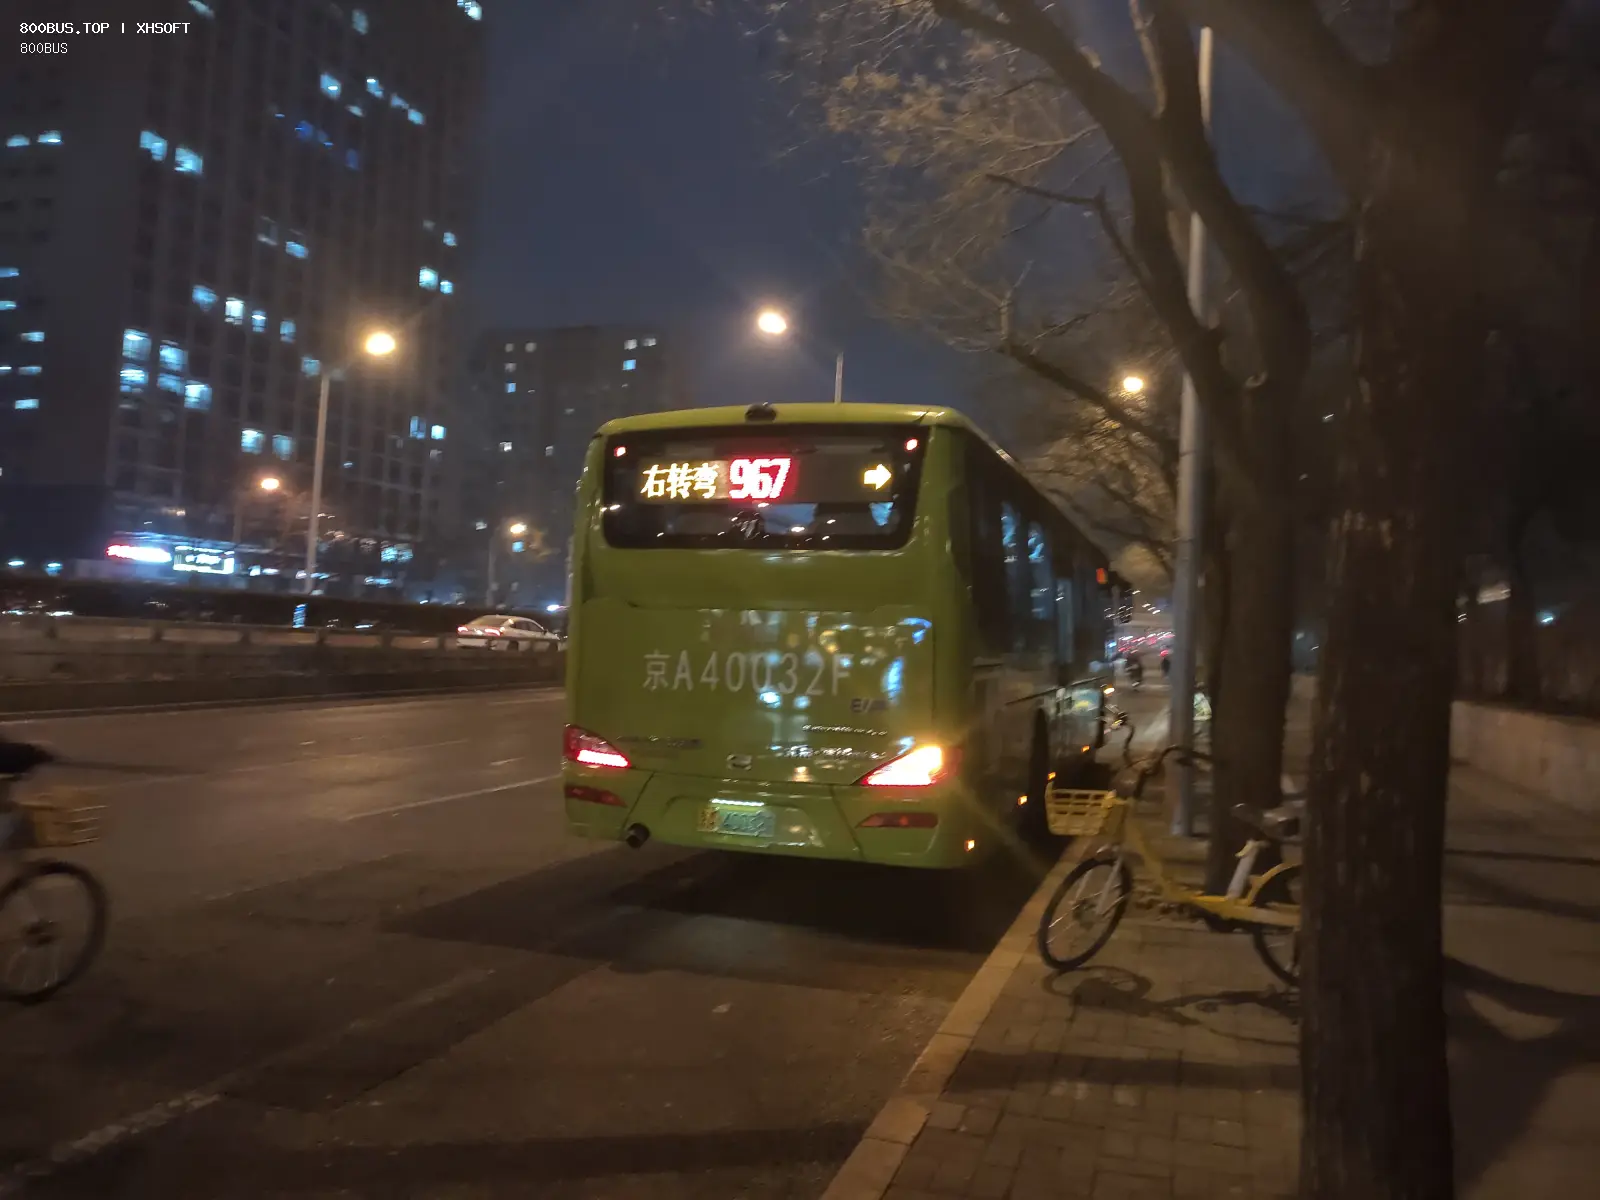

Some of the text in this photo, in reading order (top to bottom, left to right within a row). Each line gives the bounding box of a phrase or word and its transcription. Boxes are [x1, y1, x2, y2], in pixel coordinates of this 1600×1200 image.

[640, 458, 792, 499] 右转弯 967
[643, 649, 854, 695] 京A40032F
